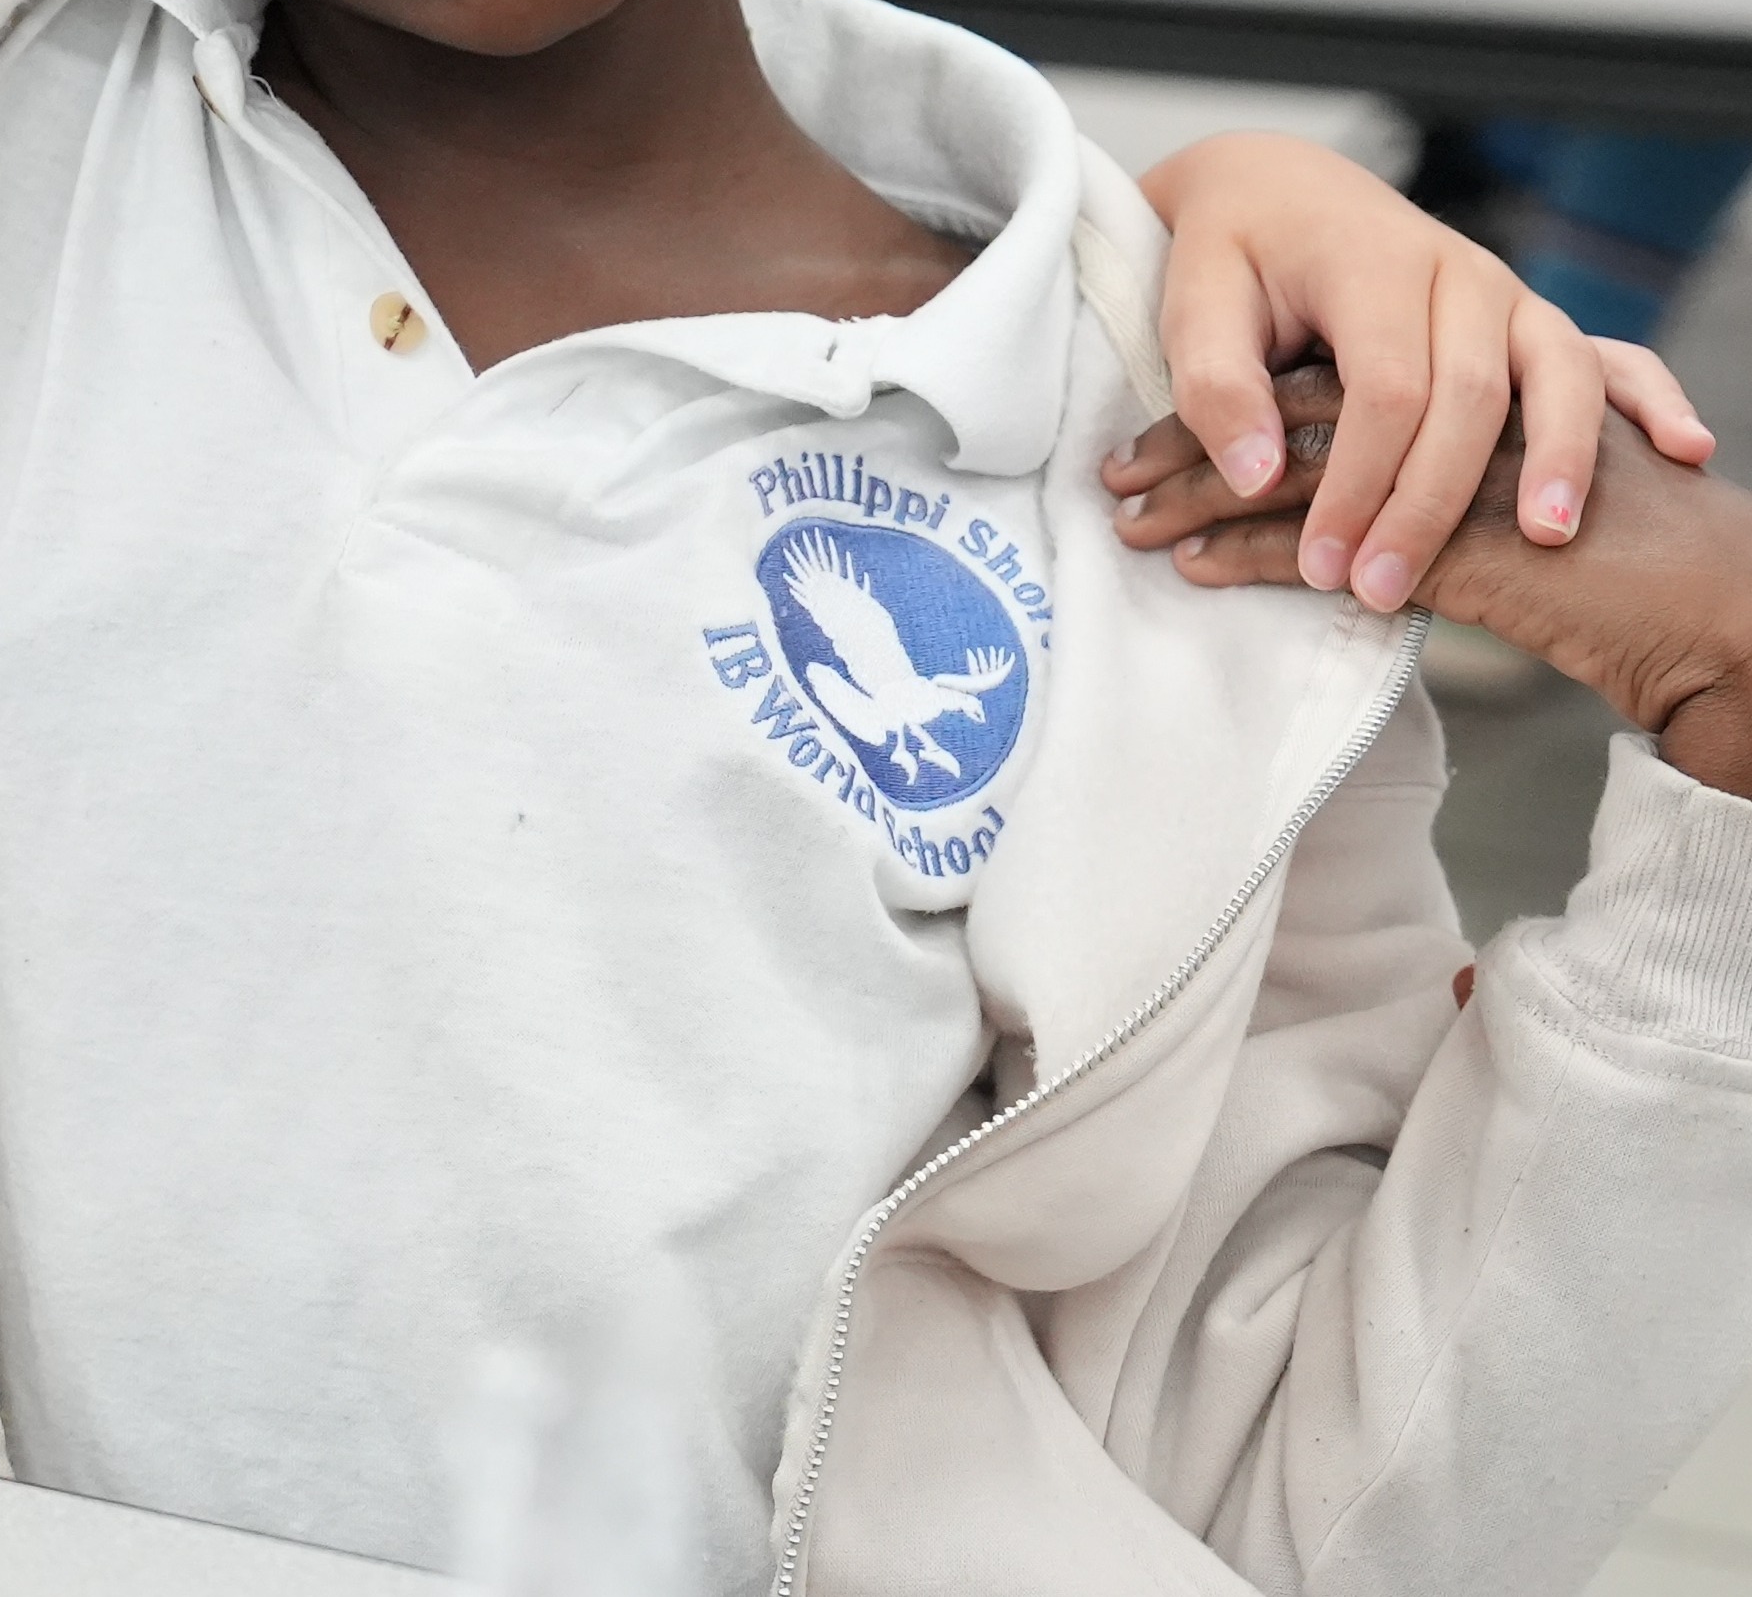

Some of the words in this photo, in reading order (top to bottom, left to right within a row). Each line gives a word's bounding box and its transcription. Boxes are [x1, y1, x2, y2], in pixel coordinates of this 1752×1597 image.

[749, 452, 950, 530] Phillippi
[703, 620, 773, 690] IB
[751, 674, 884, 824] World
